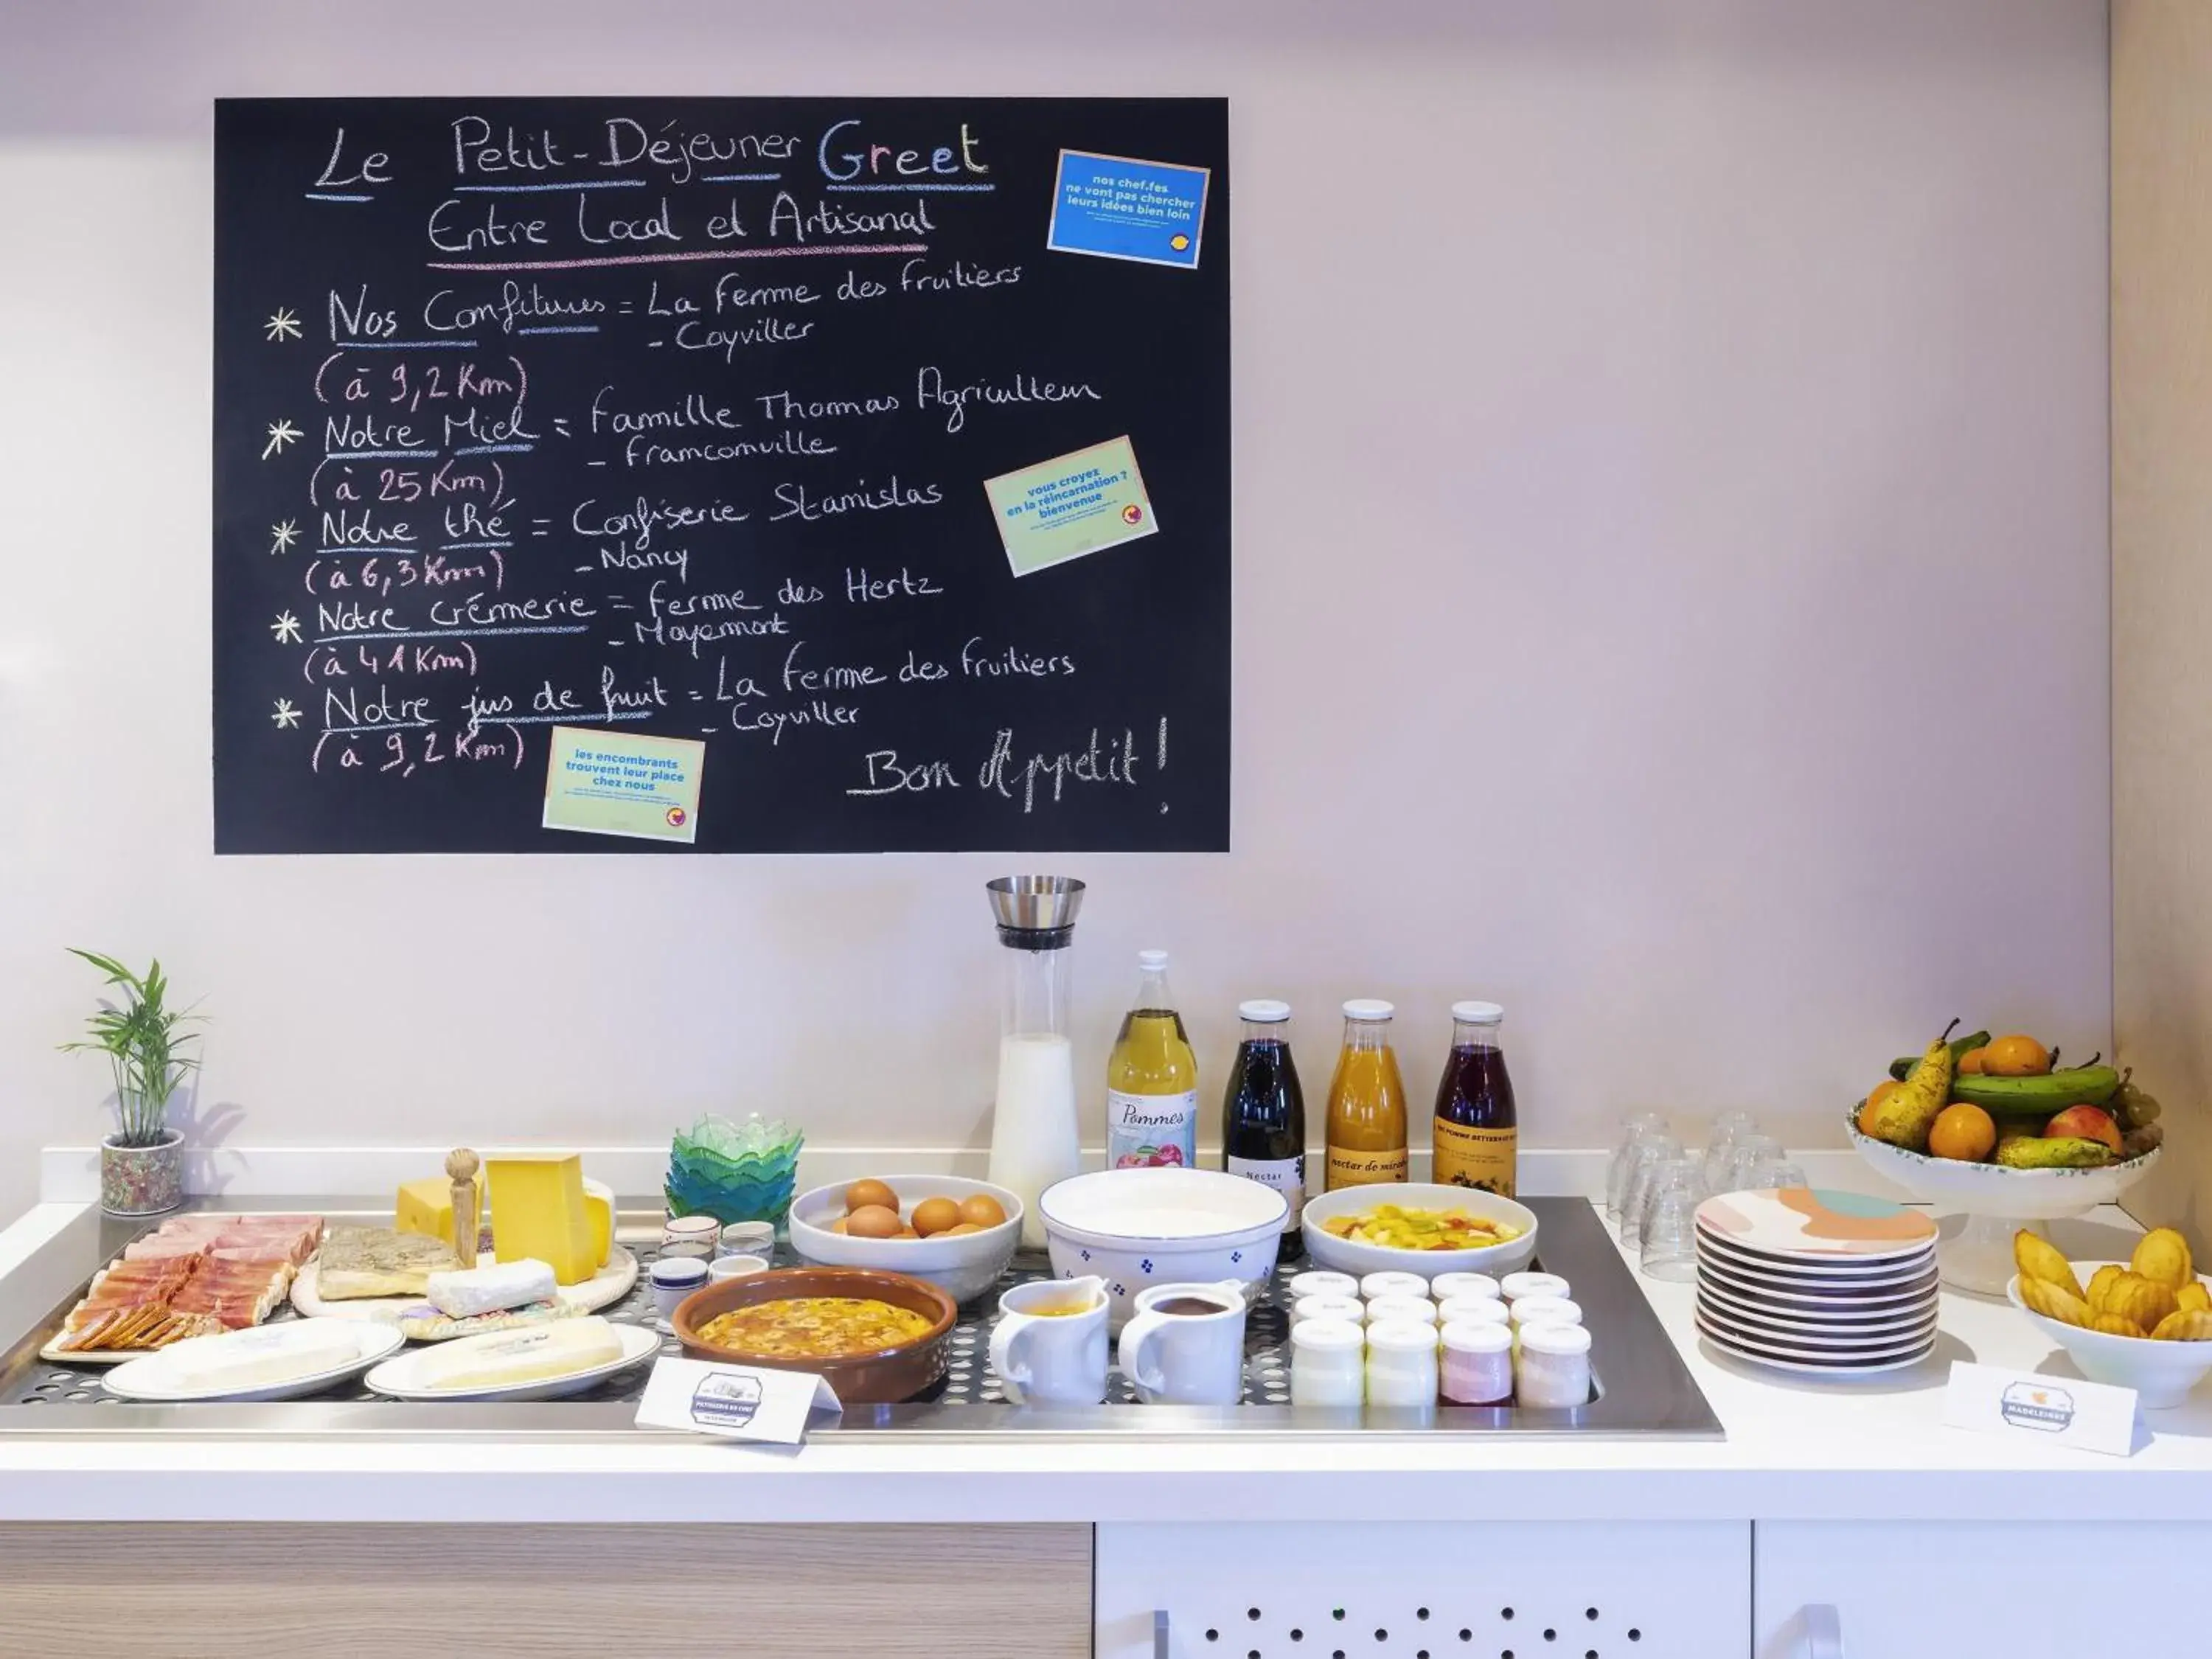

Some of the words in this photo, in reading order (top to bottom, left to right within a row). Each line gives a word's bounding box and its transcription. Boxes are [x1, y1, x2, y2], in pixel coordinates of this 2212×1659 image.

[315, 128, 393, 185] Le
[818, 119, 989, 181] Greet
[1065, 184, 1082, 193] ne
[1085, 187, 1113, 198] vont
[1116, 191, 1137, 201] pas
[1141, 193, 1196, 209] chercher
[1093, 176, 1114, 186] nos
[428, 199, 548, 251] Entre
[708, 198, 747, 238] et
[769, 192, 936, 242] Artisanal
[1067, 194, 1098, 208] leurs
[1101, 198, 1134, 212] idées
[1137, 204, 1164, 217] bien
[1167, 207, 1191, 220] loin
[329, 283, 397, 341] Nos
[648, 281, 700, 316] La
[838, 271, 887, 301] des
[325, 414, 425, 453] Notre
[445, 403, 541, 446] Miel
[754, 389, 900, 420] Thomas
[1006, 507, 1023, 518] en
[1025, 501, 1037, 511] la
[1038, 475, 1119, 507] réincarnation
[1027, 483, 1057, 497] vous
[1060, 467, 1101, 487] croyez
[322, 508, 418, 546] Notre
[445, 497, 517, 538] thé
[573, 496, 748, 550] Confiserie
[770, 475, 943, 521] Stanislas
[1038, 493, 1104, 519] bienvenue
[601, 540, 689, 585] Nancy
[319, 599, 410, 632] Notre
[778, 577, 824, 604] des
[846, 566, 945, 602] Hertz
[324, 684, 440, 728] Notre
[462, 686, 513, 739] jus
[533, 680, 582, 712] de
[599, 665, 669, 724] fruit
[717, 655, 769, 700] La
[899, 650, 950, 681] des
[566, 760, 621, 774] trouvent
[624, 767, 647, 778] leur
[651, 770, 685, 782] place
[575, 748, 592, 760] les
[597, 752, 679, 770] encombrants
[846, 749, 961, 796] Bon
[592, 775, 622, 788] chez
[625, 781, 655, 791] nous
[1122, 1103, 1184, 1126] Pommes
[1246, 1170, 1282, 1180] Nectar
